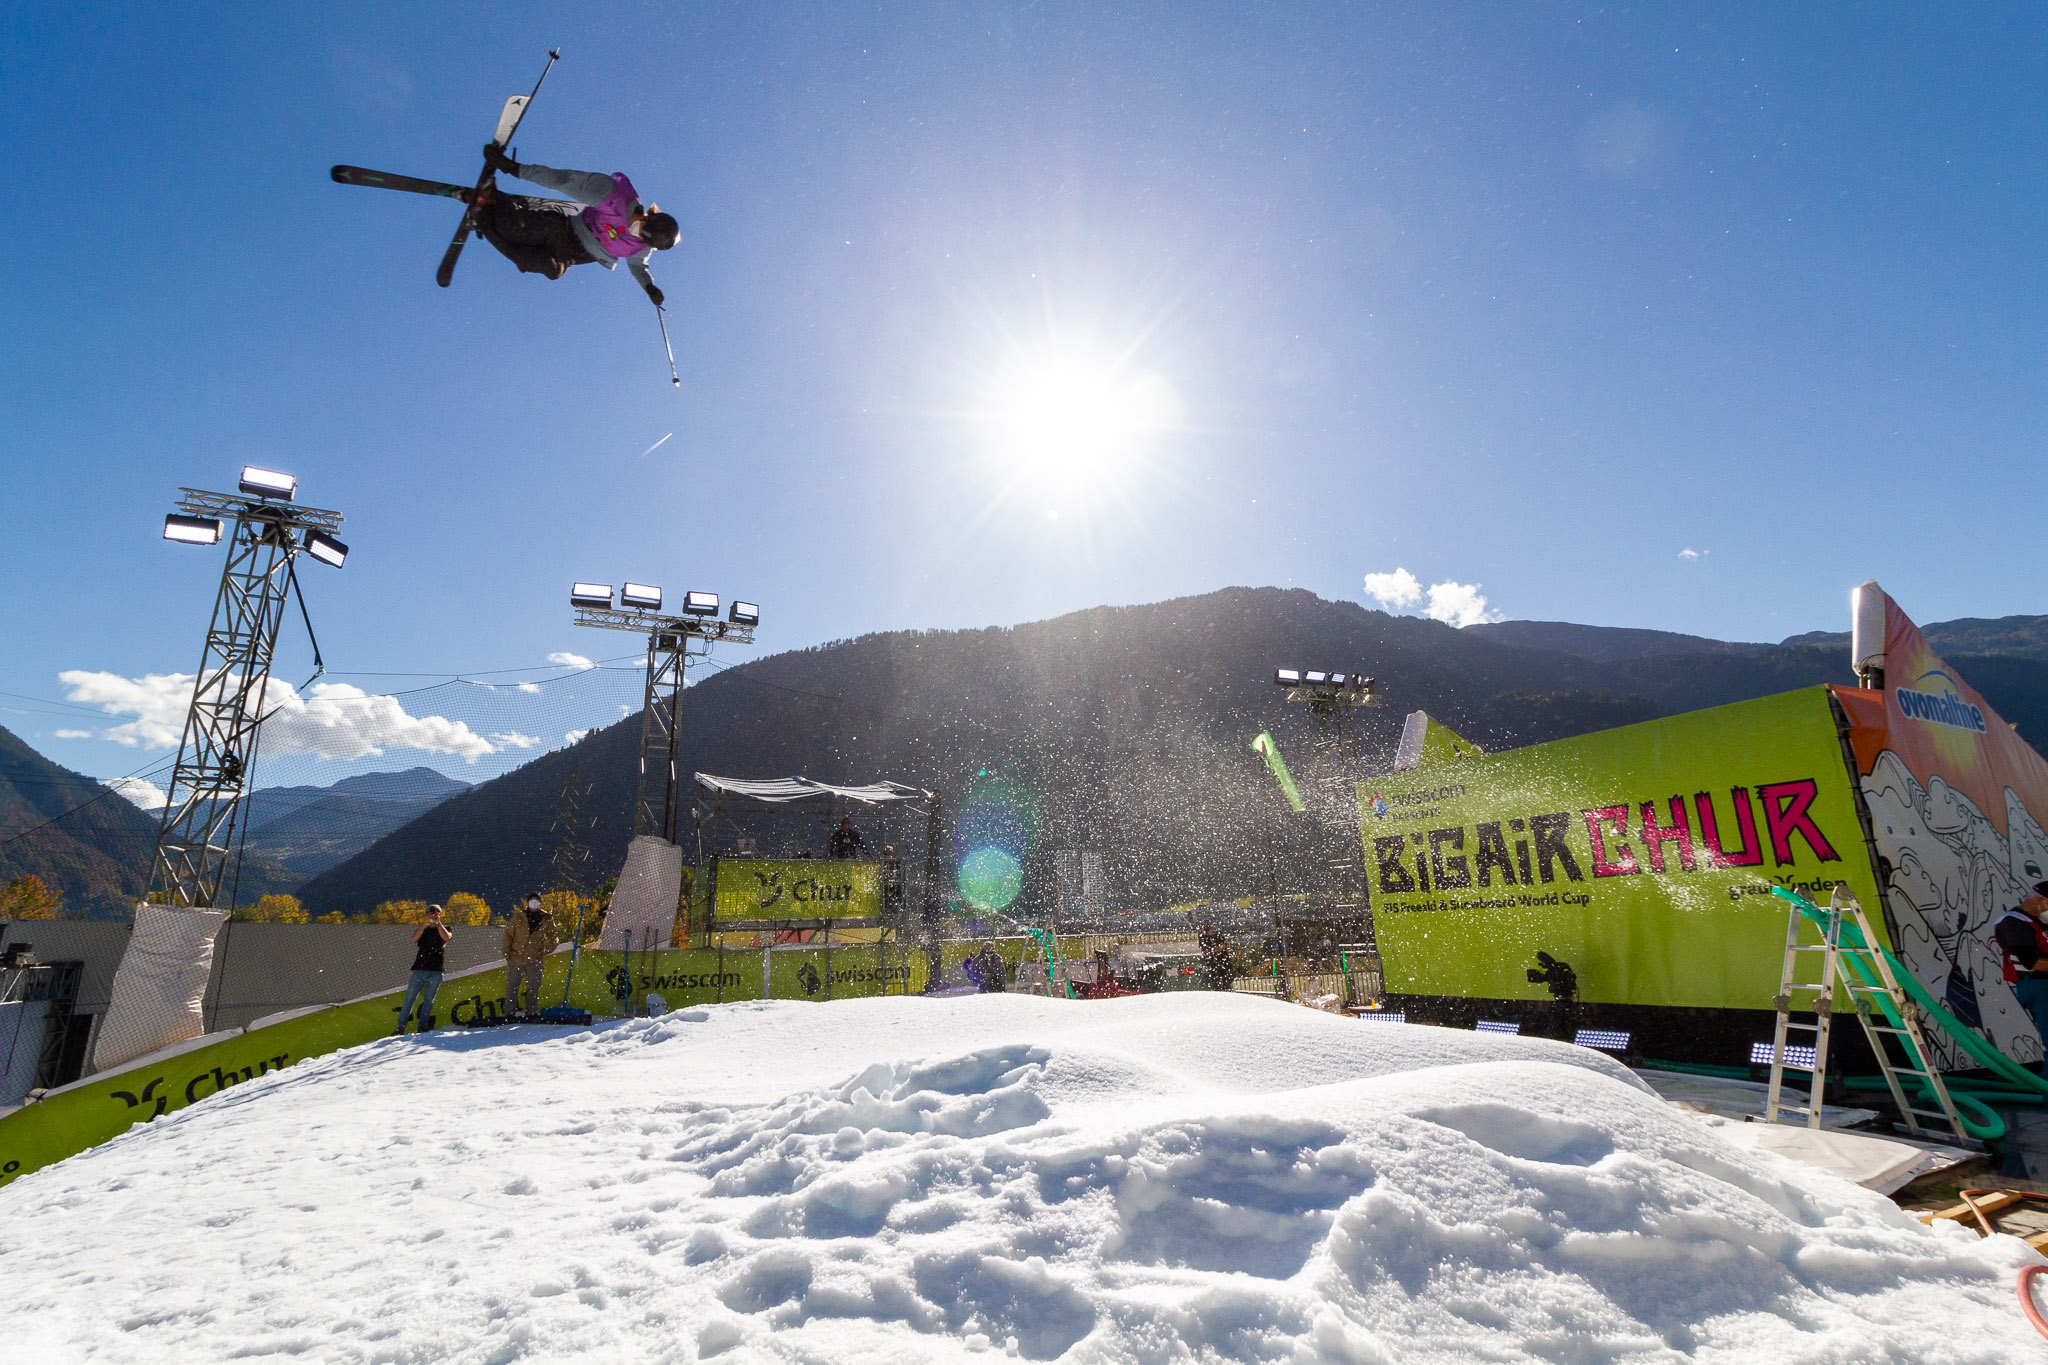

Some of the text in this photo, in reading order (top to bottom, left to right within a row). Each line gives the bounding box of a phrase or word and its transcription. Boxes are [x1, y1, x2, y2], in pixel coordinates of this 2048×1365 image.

[1896, 687, 1987, 734] ovomaltine
[1391, 784, 1466, 807] swisscom
[1581, 778, 1843, 878] CHUR
[793, 878, 852, 901] Chur
[1384, 890, 1590, 913] FIS Freeski & Snowboard World Cup
[640, 969, 740, 990] swisscom
[827, 964, 911, 984] swisscom
